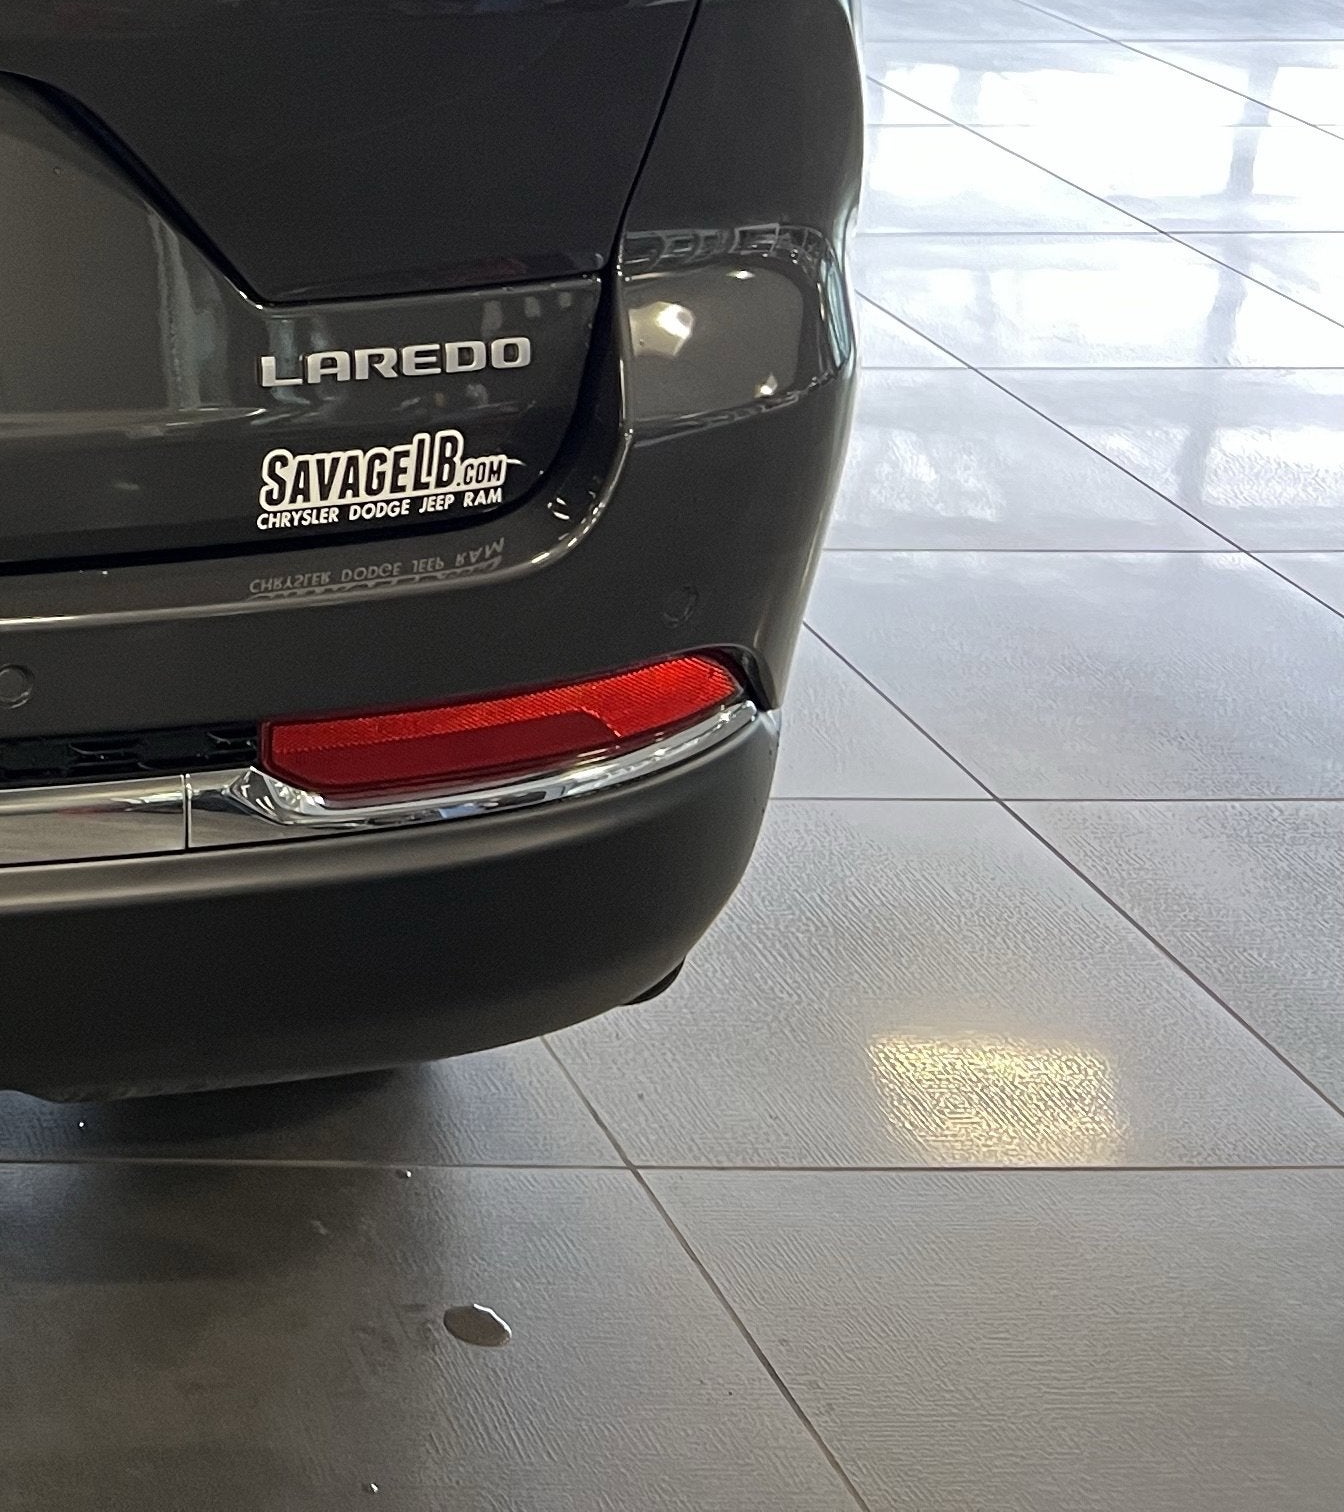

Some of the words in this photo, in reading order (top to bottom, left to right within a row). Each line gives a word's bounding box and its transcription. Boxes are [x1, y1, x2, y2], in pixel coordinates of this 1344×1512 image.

[259, 336, 532, 388] LAREDO
[256, 506, 340, 530] CHRYSLER
[348, 498, 411, 521] DODGE
[418, 493, 455, 514] JEEP
[462, 487, 503, 508] RAM
